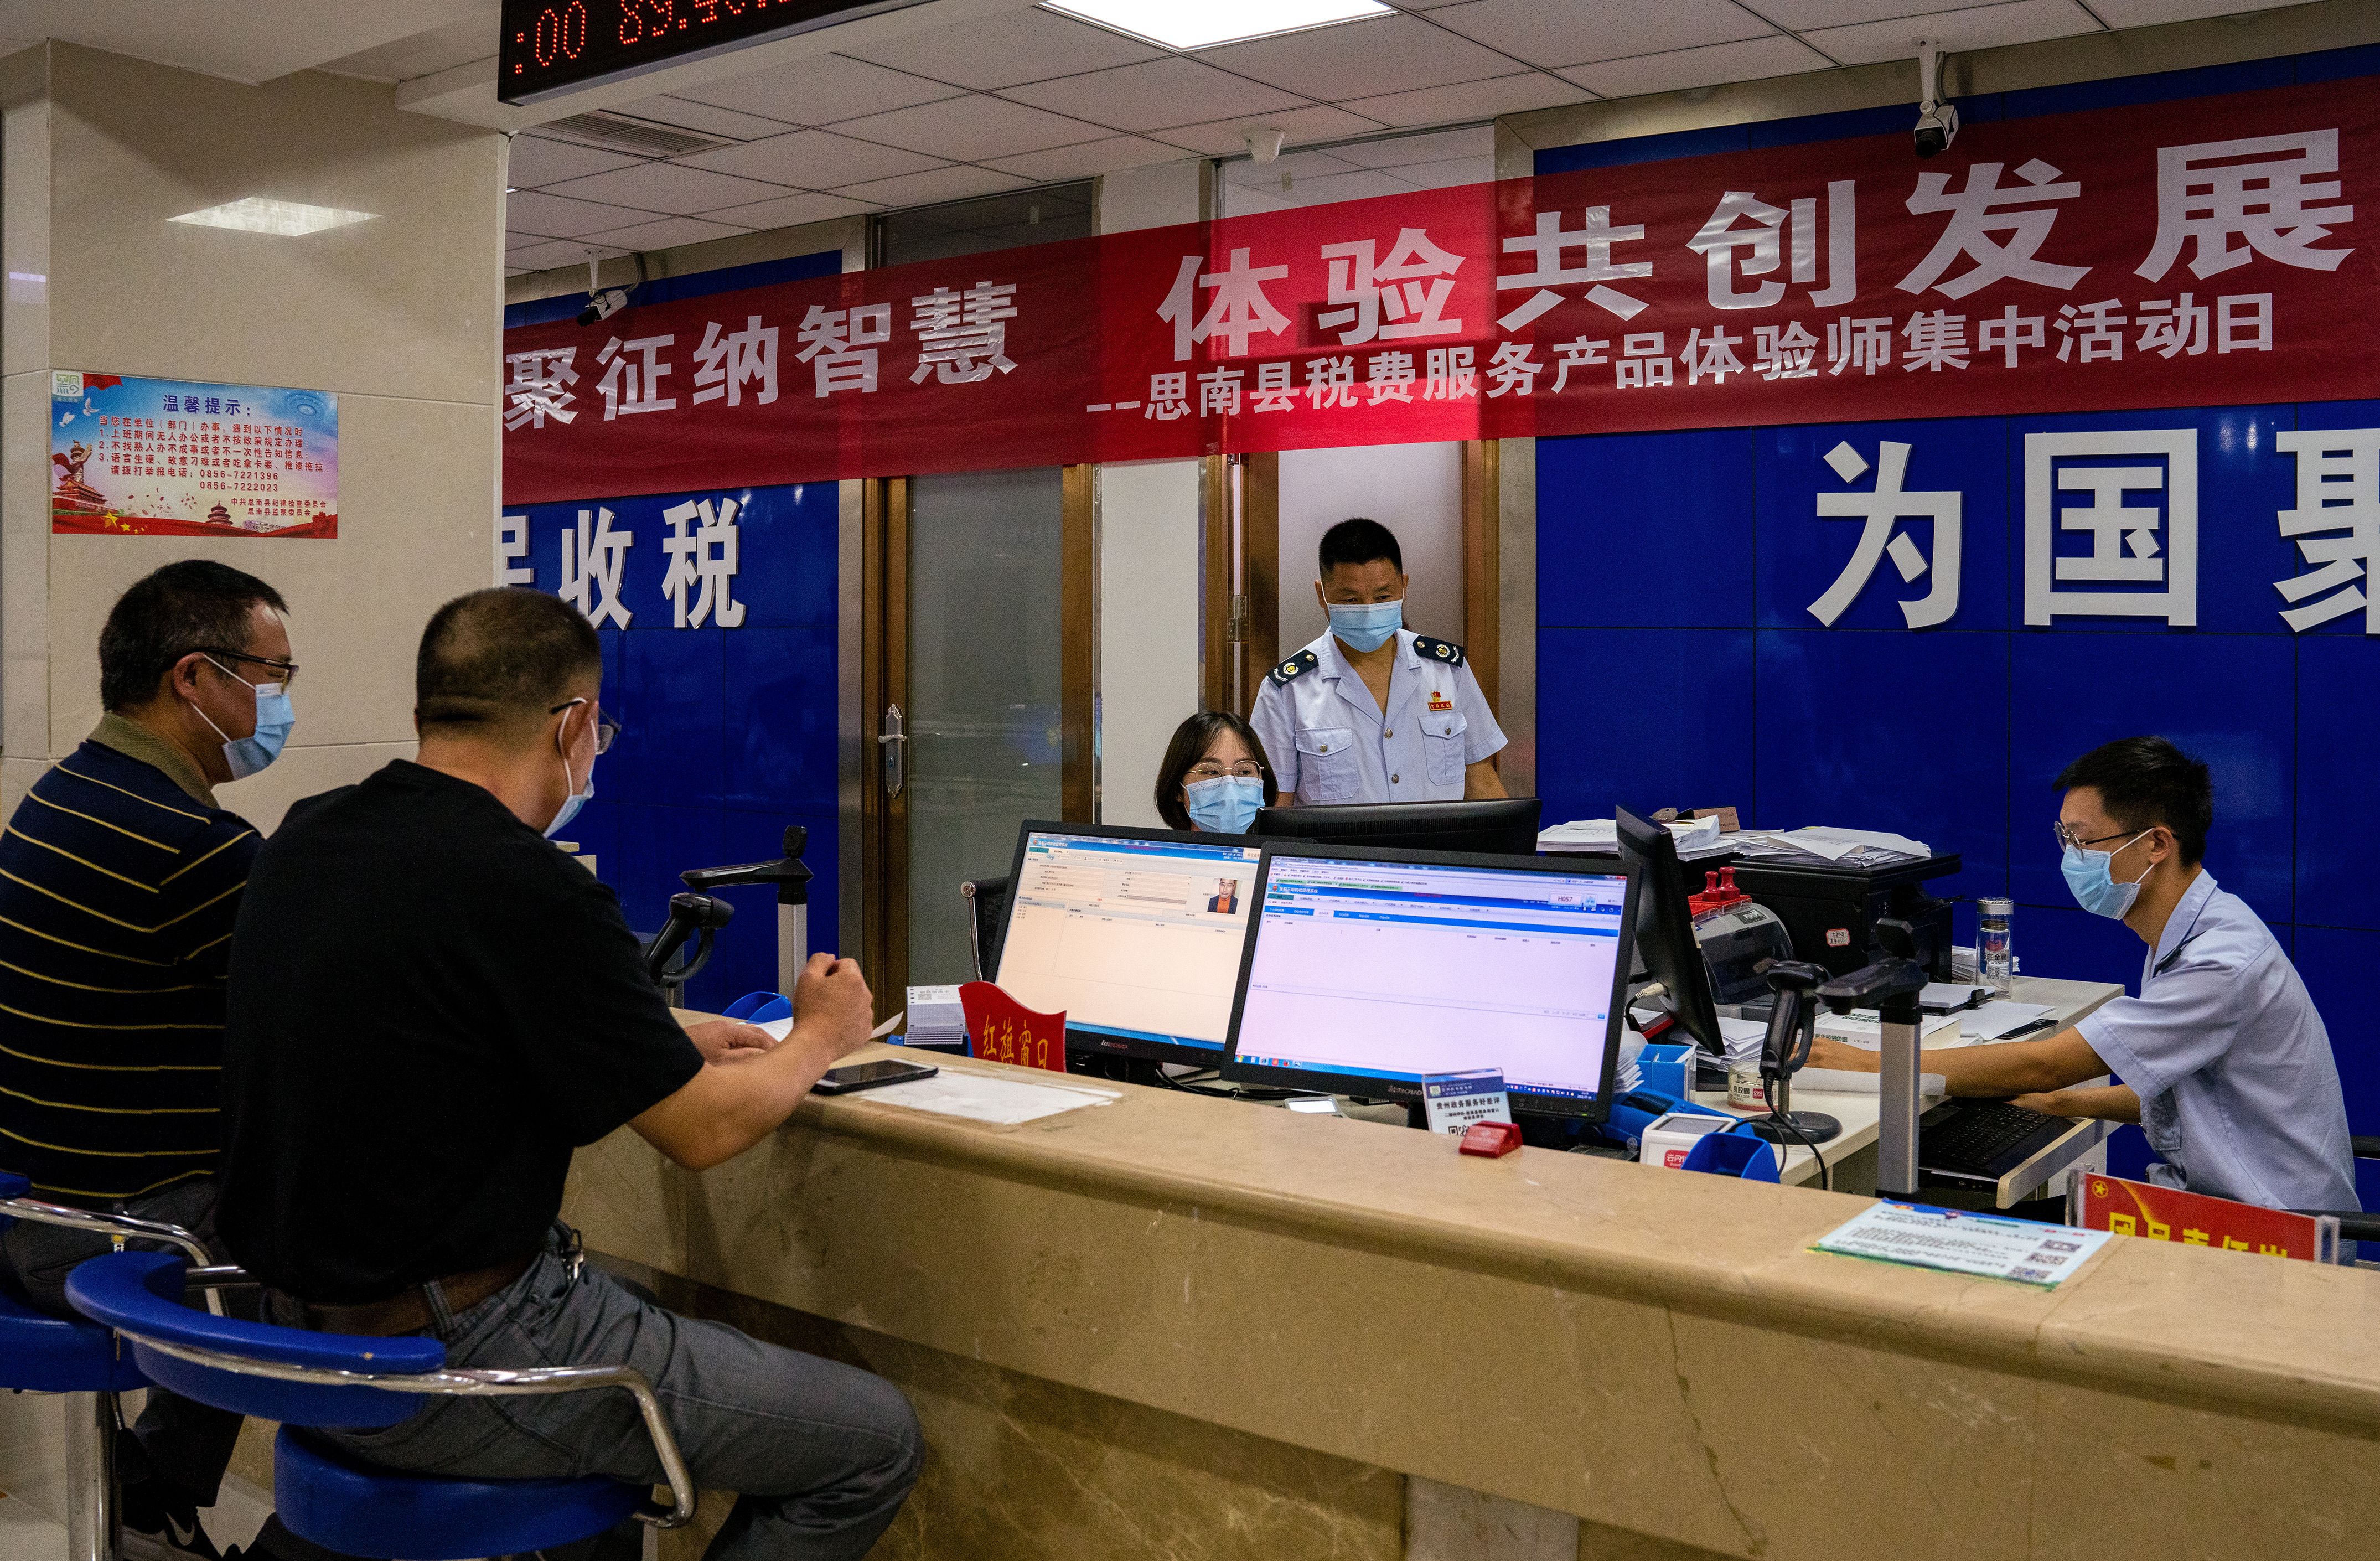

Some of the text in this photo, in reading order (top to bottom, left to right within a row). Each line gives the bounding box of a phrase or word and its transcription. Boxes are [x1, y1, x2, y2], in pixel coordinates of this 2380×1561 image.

[504, 127, 2357, 432] 聚征纳智慧 体验共创发展
[163, 394, 250, 416] 温馨提示：
[200, 481, 278, 492] 0856-7222023
[231, 498, 327, 508] 中共思南县纪律检查委员会
[248, 508, 311, 516] 思南县监察委员会
[983, 1015, 1048, 1069] 红旗窗口
